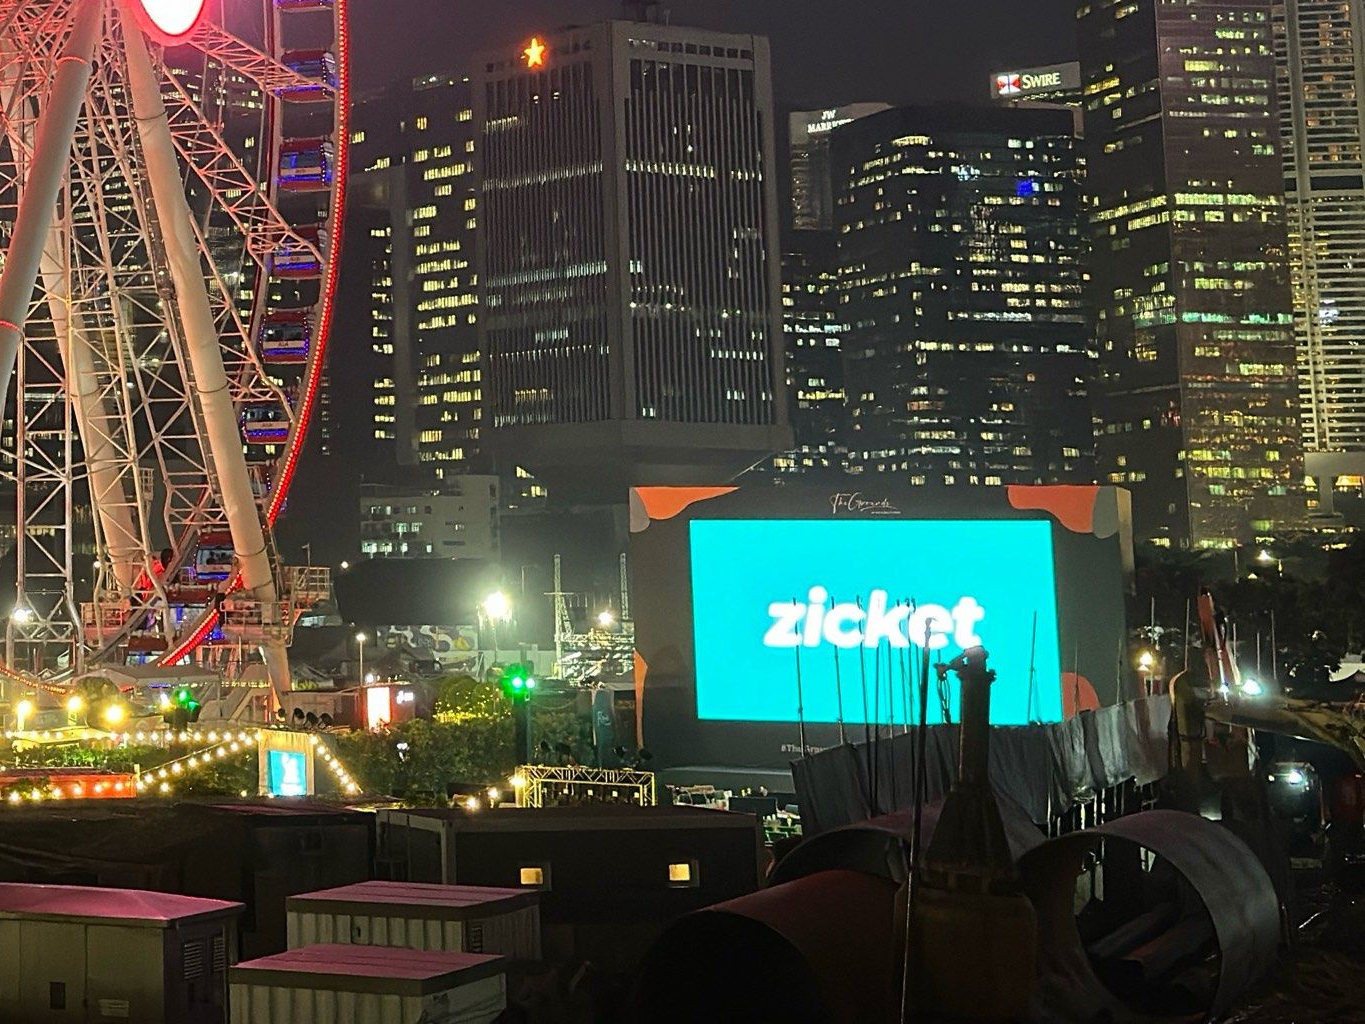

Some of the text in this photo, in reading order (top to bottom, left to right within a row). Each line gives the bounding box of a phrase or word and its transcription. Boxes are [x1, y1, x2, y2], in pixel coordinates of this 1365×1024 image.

[1022, 72, 1061, 89] SWIRE
[821, 109, 836, 120] JW
[763, 585, 985, 650] zicket
